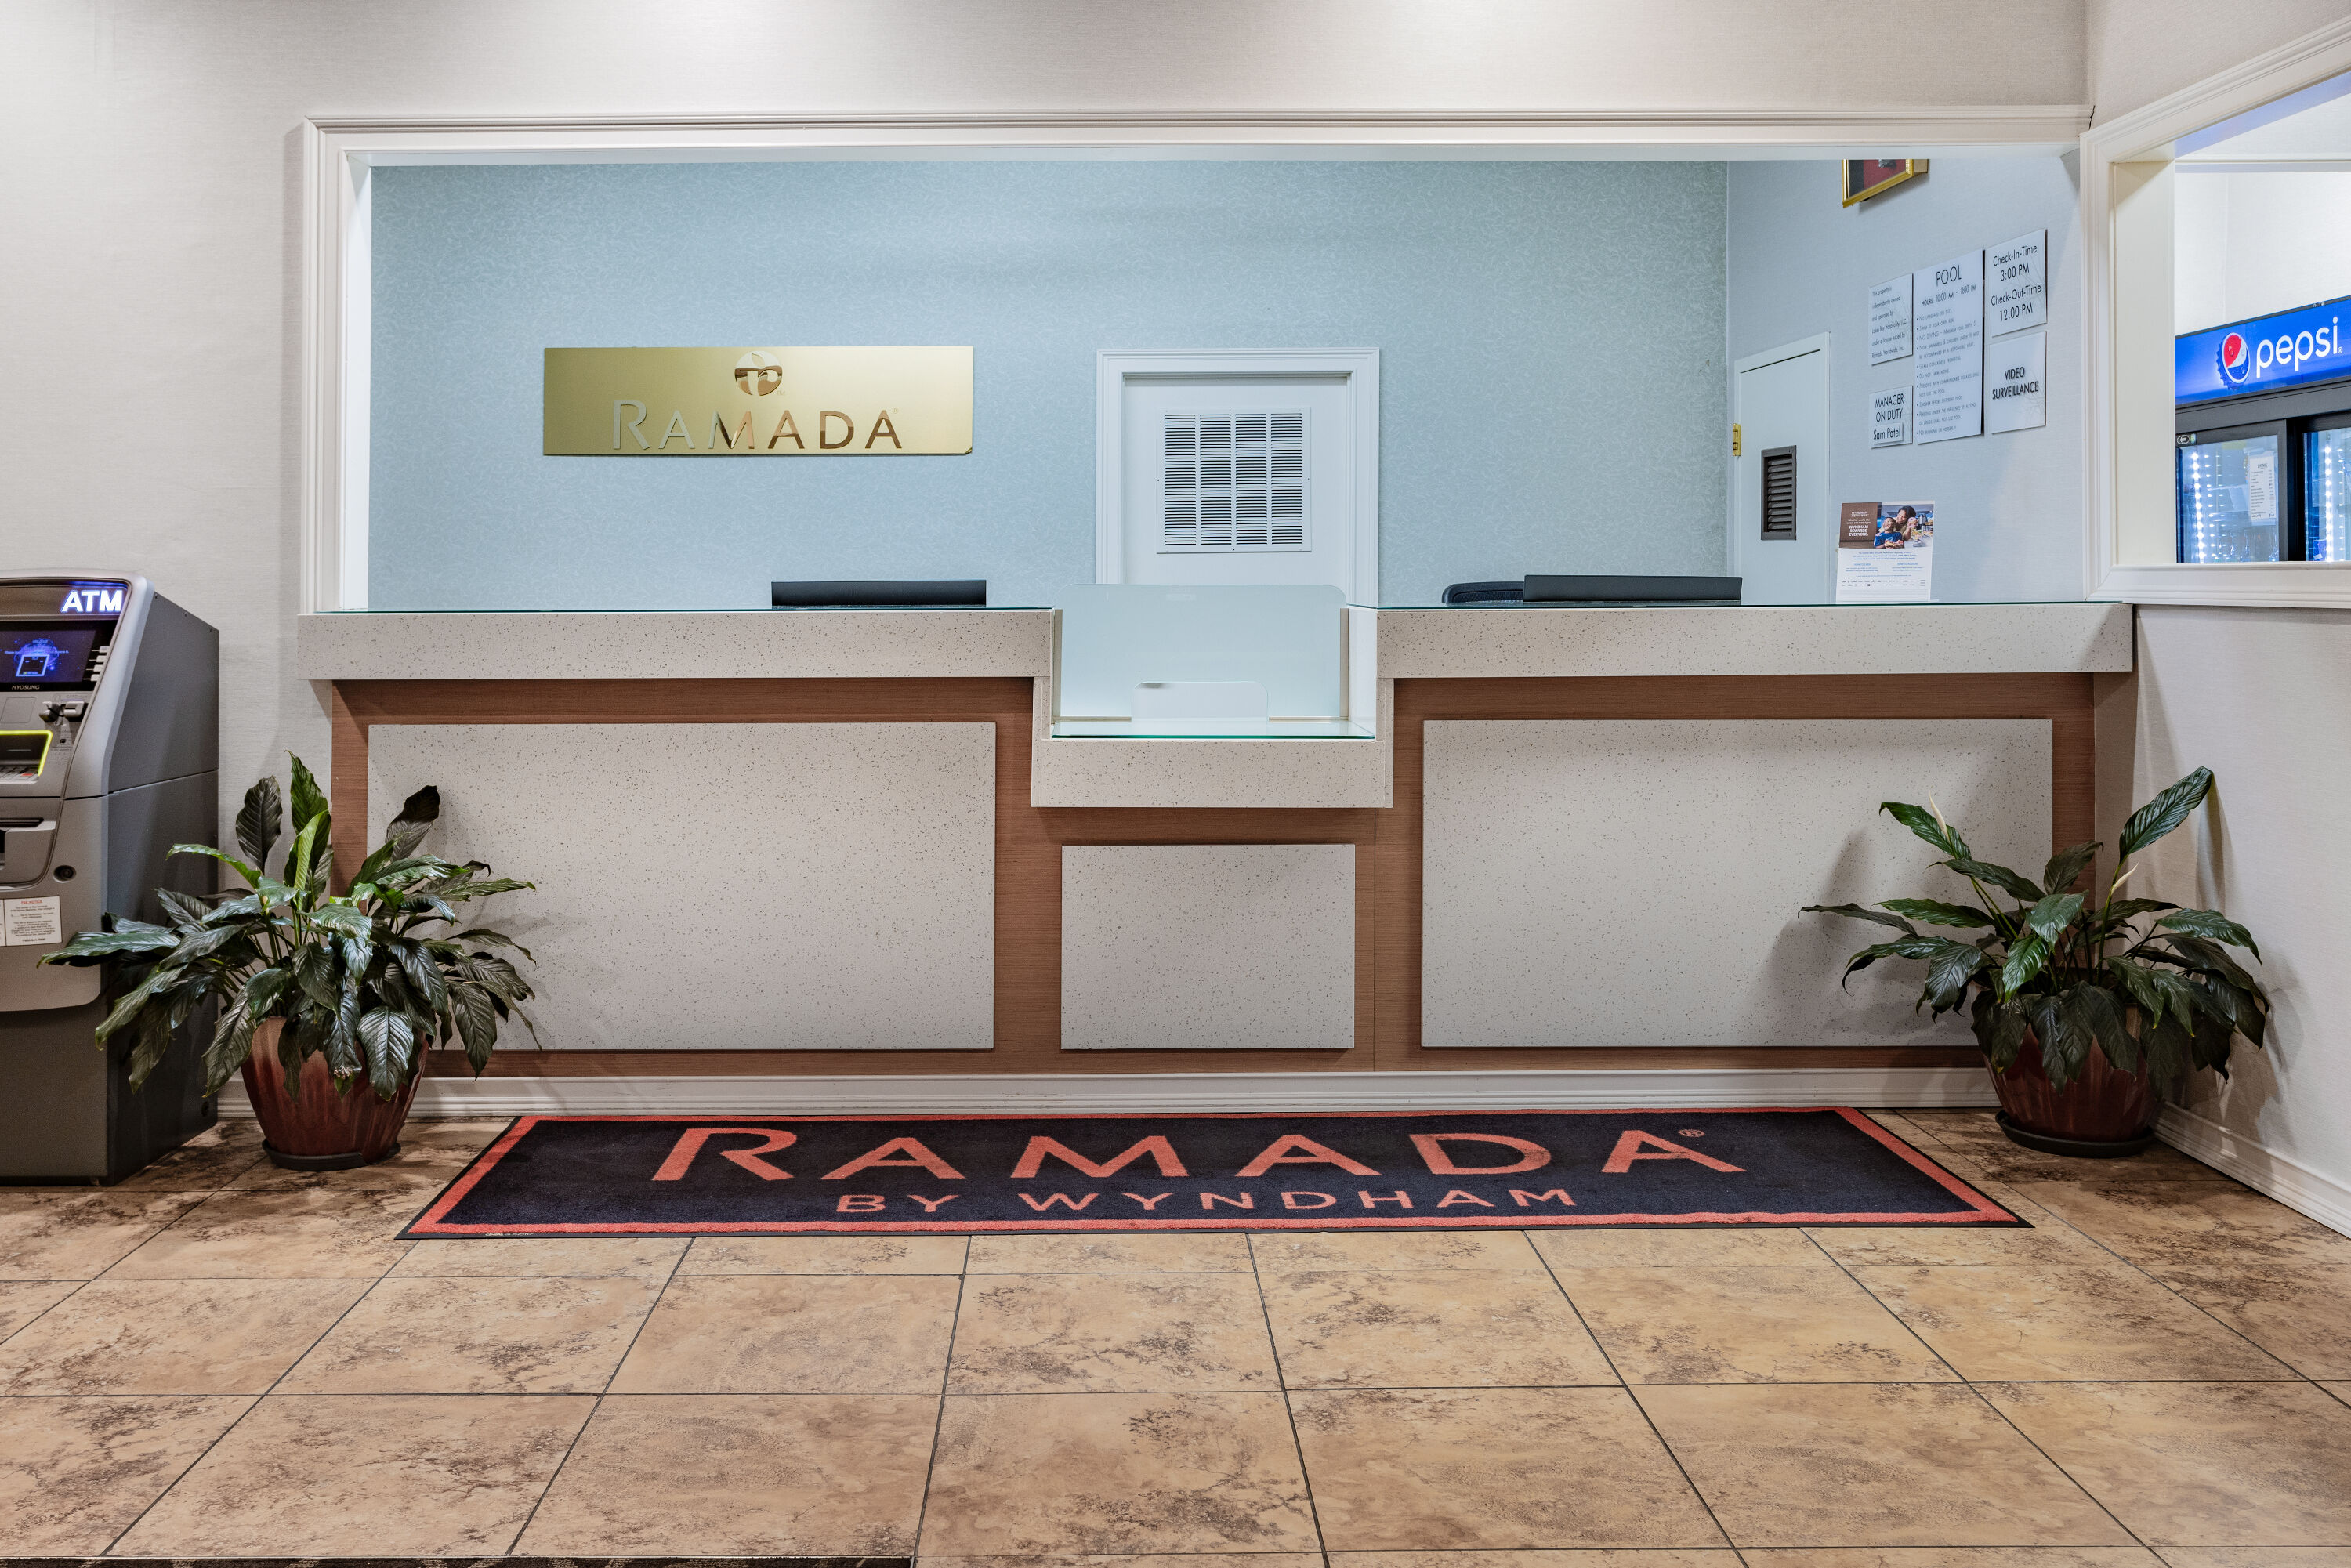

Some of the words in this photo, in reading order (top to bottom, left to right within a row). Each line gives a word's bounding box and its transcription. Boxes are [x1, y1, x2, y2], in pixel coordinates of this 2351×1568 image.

[1993, 245, 2038, 266] Check-In-Time
[1936, 264, 1962, 286] POOL
[2001, 266, 2016, 281] 3:00
[2018, 263, 2030, 276] PM
[1991, 284, 2041, 306] Check-Out-Time
[2000, 306, 2019, 321] 12:00
[2022, 302, 2033, 316] PM
[2255, 316, 2337, 378] pepsi
[2005, 367, 2025, 380] VIDEO
[1875, 393, 1904, 408] MANAGER
[1992, 381, 2038, 400] SURVEILLANCE
[613, 400, 902, 449] RAMADA
[1876, 411, 1886, 422] ON
[1888, 408, 1903, 421] DUTY
[1874, 429, 1885, 440] Sam
[1887, 425, 1900, 438] Patel
[61, 589, 122, 613] ATM
[650, 1128, 1747, 1181] RAMADA
[836, 1194, 960, 1213] BY
[1019, 1189, 1576, 1211] WYNDHAM
